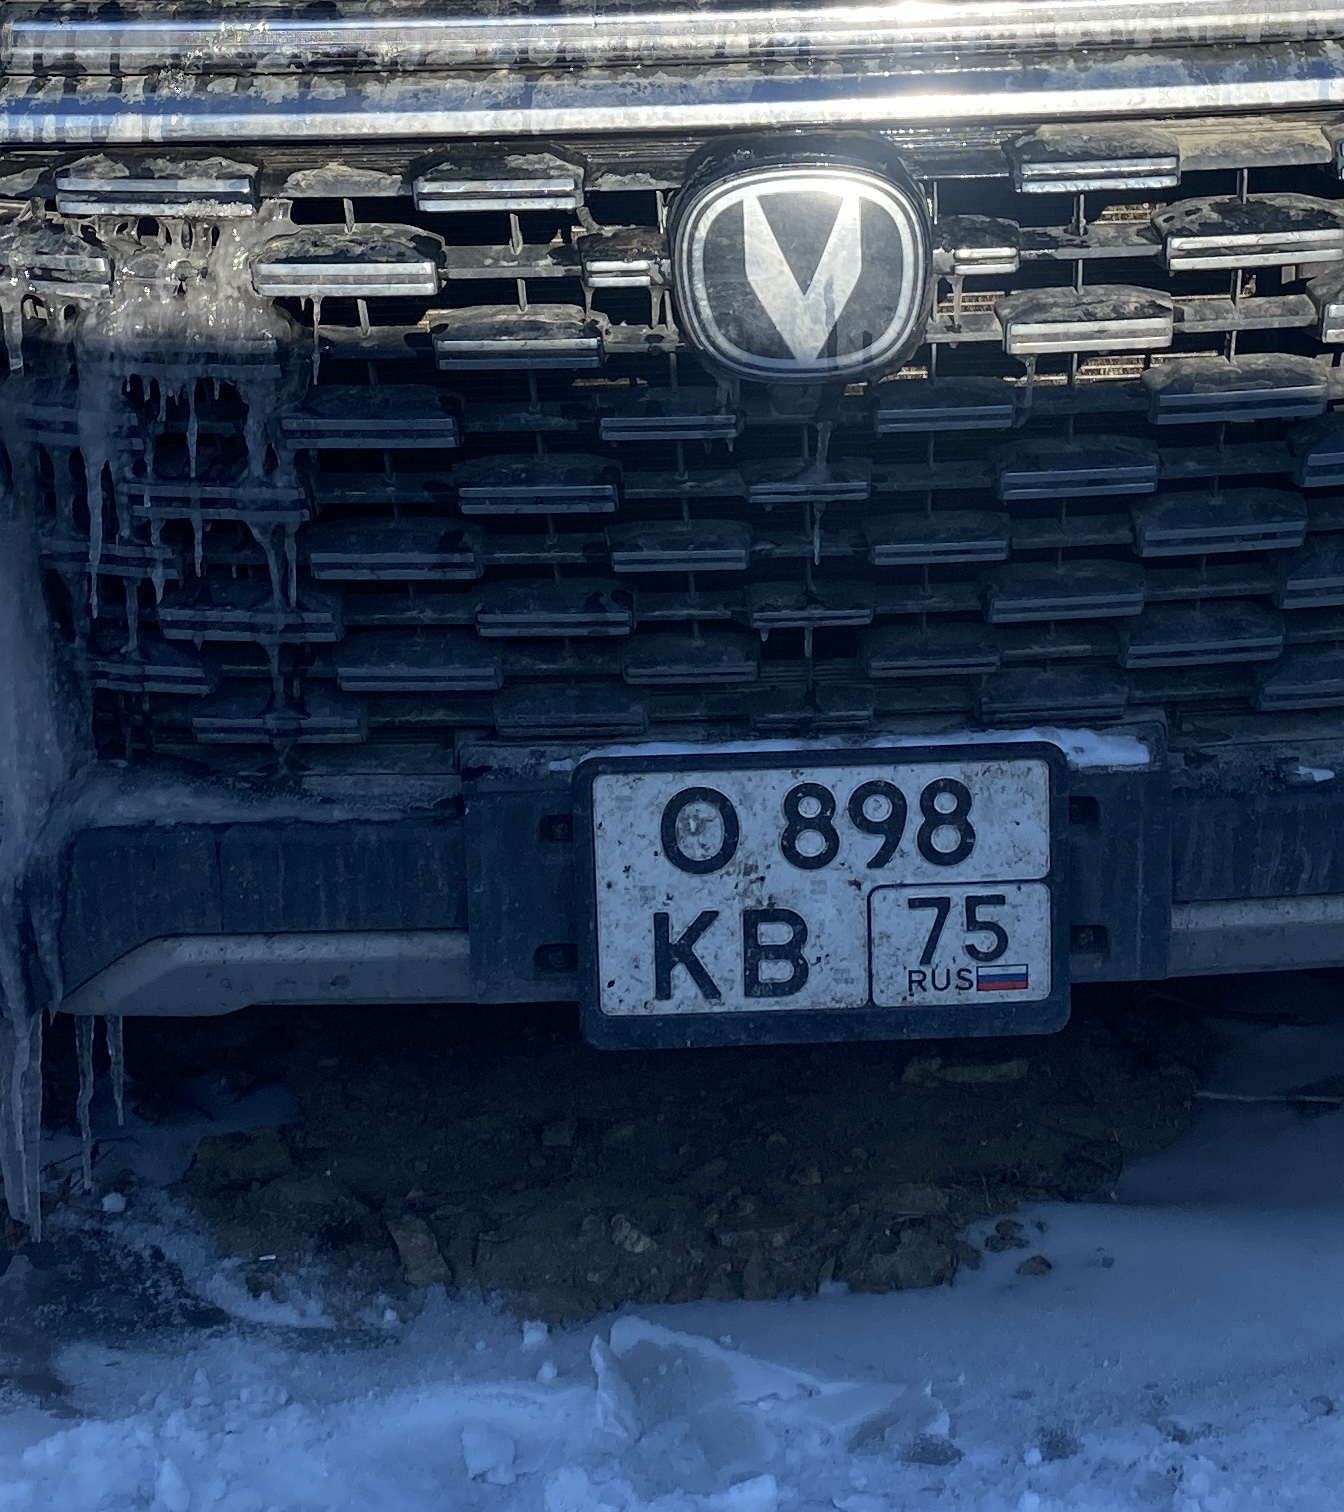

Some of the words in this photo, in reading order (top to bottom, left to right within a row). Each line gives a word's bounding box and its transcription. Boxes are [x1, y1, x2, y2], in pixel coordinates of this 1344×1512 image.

[660, 786, 740, 875] O
[780, 777, 977, 870] 898
[654, 907, 810, 1002] KB
[907, 894, 1009, 966] 75
[907, 967, 975, 993] RUS
